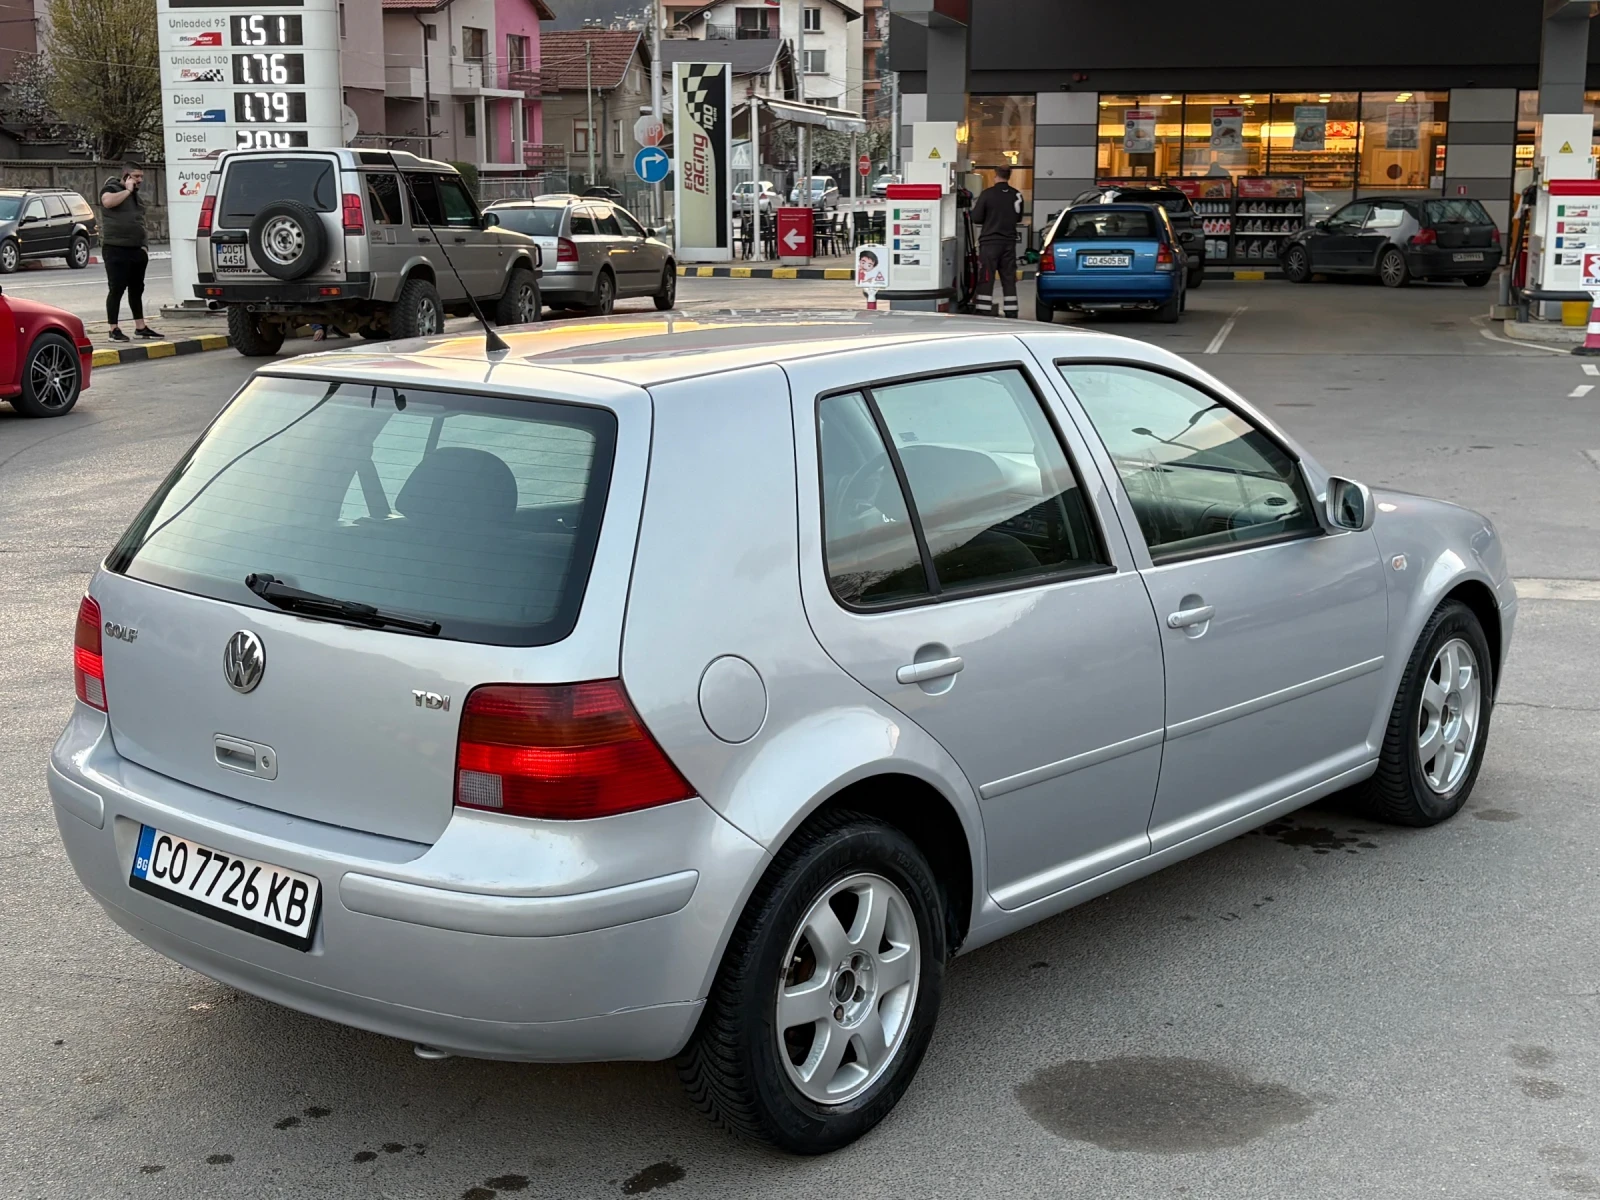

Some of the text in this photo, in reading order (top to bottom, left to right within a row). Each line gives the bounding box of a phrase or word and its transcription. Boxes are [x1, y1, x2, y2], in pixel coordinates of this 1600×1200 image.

[169, 18, 226, 28] Unleaded 95
[240, 14, 286, 46] 1.51
[170, 56, 228, 64] Unleaded 100
[242, 54, 288, 84] 1.76
[173, 94, 204, 104] Diesel
[244, 92, 288, 122] 1.79
[703, 104, 713, 130] 100
[176, 132, 206, 142] Diesel
[692, 133, 708, 194] racing
[684, 161, 692, 190] EKO
[222, 245, 243, 254] COCT
[223, 255, 244, 264] 4456
[1099, 257, 1117, 265] 4505
[104, 620, 138, 643] GOLF
[412, 689, 451, 712] TDI
[137, 857, 149, 872] BG
[152, 835, 308, 928] CO 7726 KB
